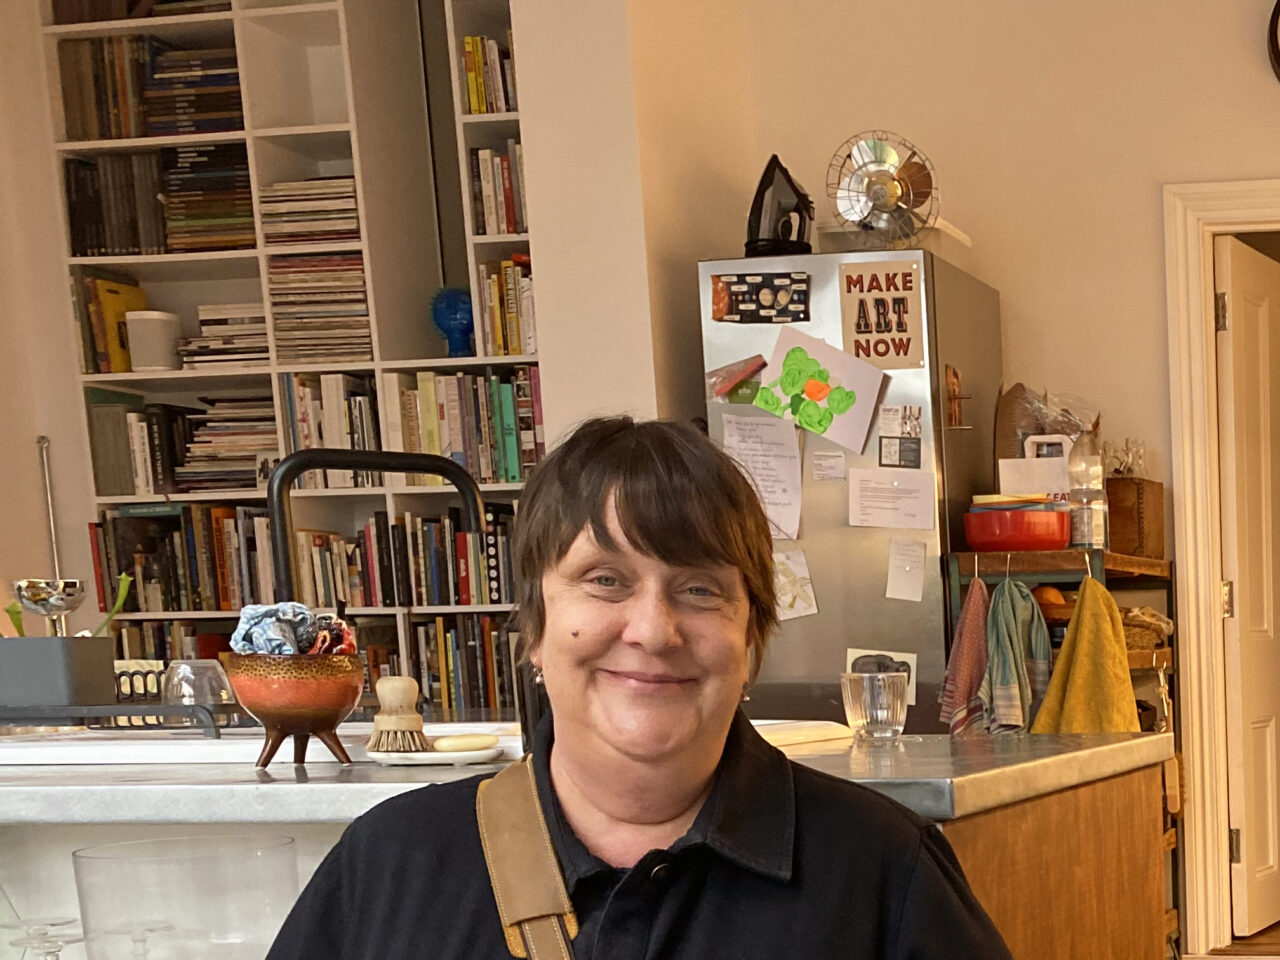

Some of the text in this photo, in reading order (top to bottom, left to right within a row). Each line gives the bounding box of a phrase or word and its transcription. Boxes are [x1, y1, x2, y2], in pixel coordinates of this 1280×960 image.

[845, 272, 913, 294] MAKE
[855, 296, 909, 334] ART
[854, 337, 912, 358] NOW
